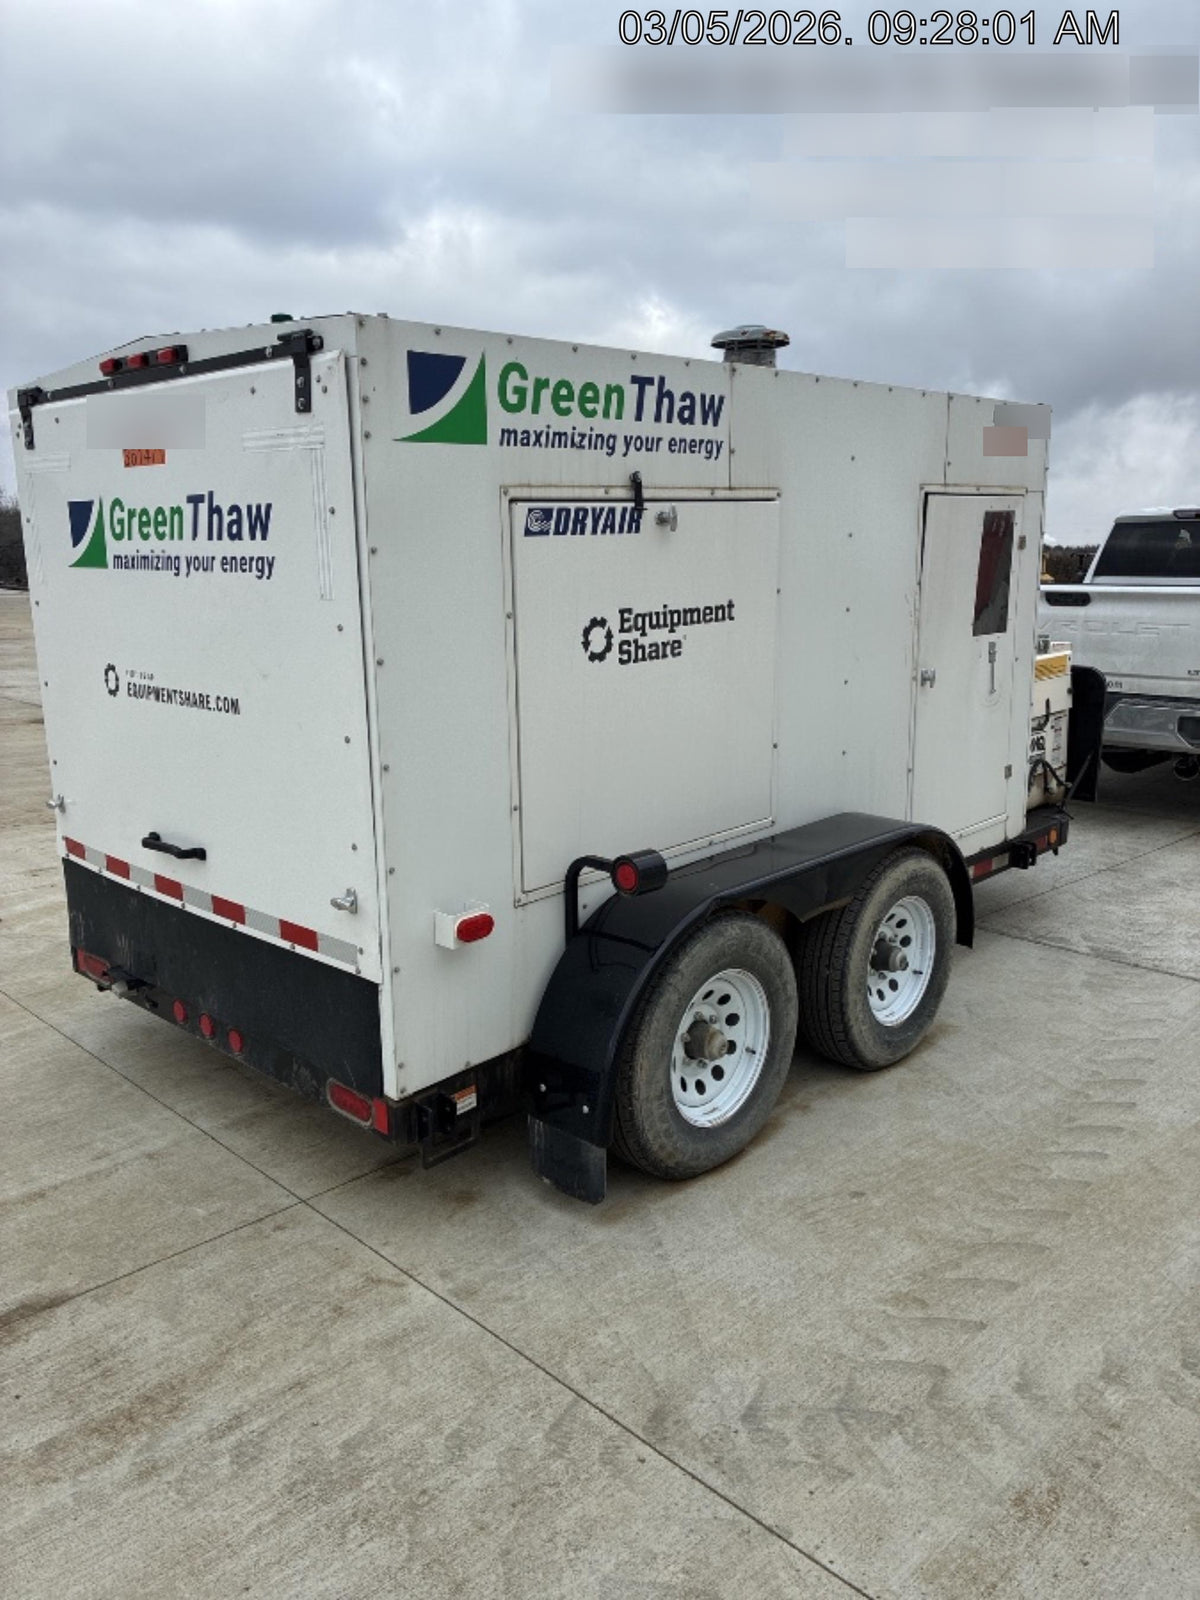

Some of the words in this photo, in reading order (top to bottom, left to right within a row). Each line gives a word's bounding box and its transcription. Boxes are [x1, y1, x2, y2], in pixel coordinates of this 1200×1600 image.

[498, 362, 725, 426] GreenThaw
[499, 424, 617, 458] maximizing
[622, 433, 663, 457] your
[667, 435, 724, 461] energy
[109, 490, 272, 541] GreenThaw
[552, 506, 642, 536] DRYAIR
[112, 549, 181, 577] maximizing
[185, 555, 216, 578] your
[220, 554, 276, 580] energy
[618, 599, 735, 637] Equipment
[618, 638, 682, 665] Share
